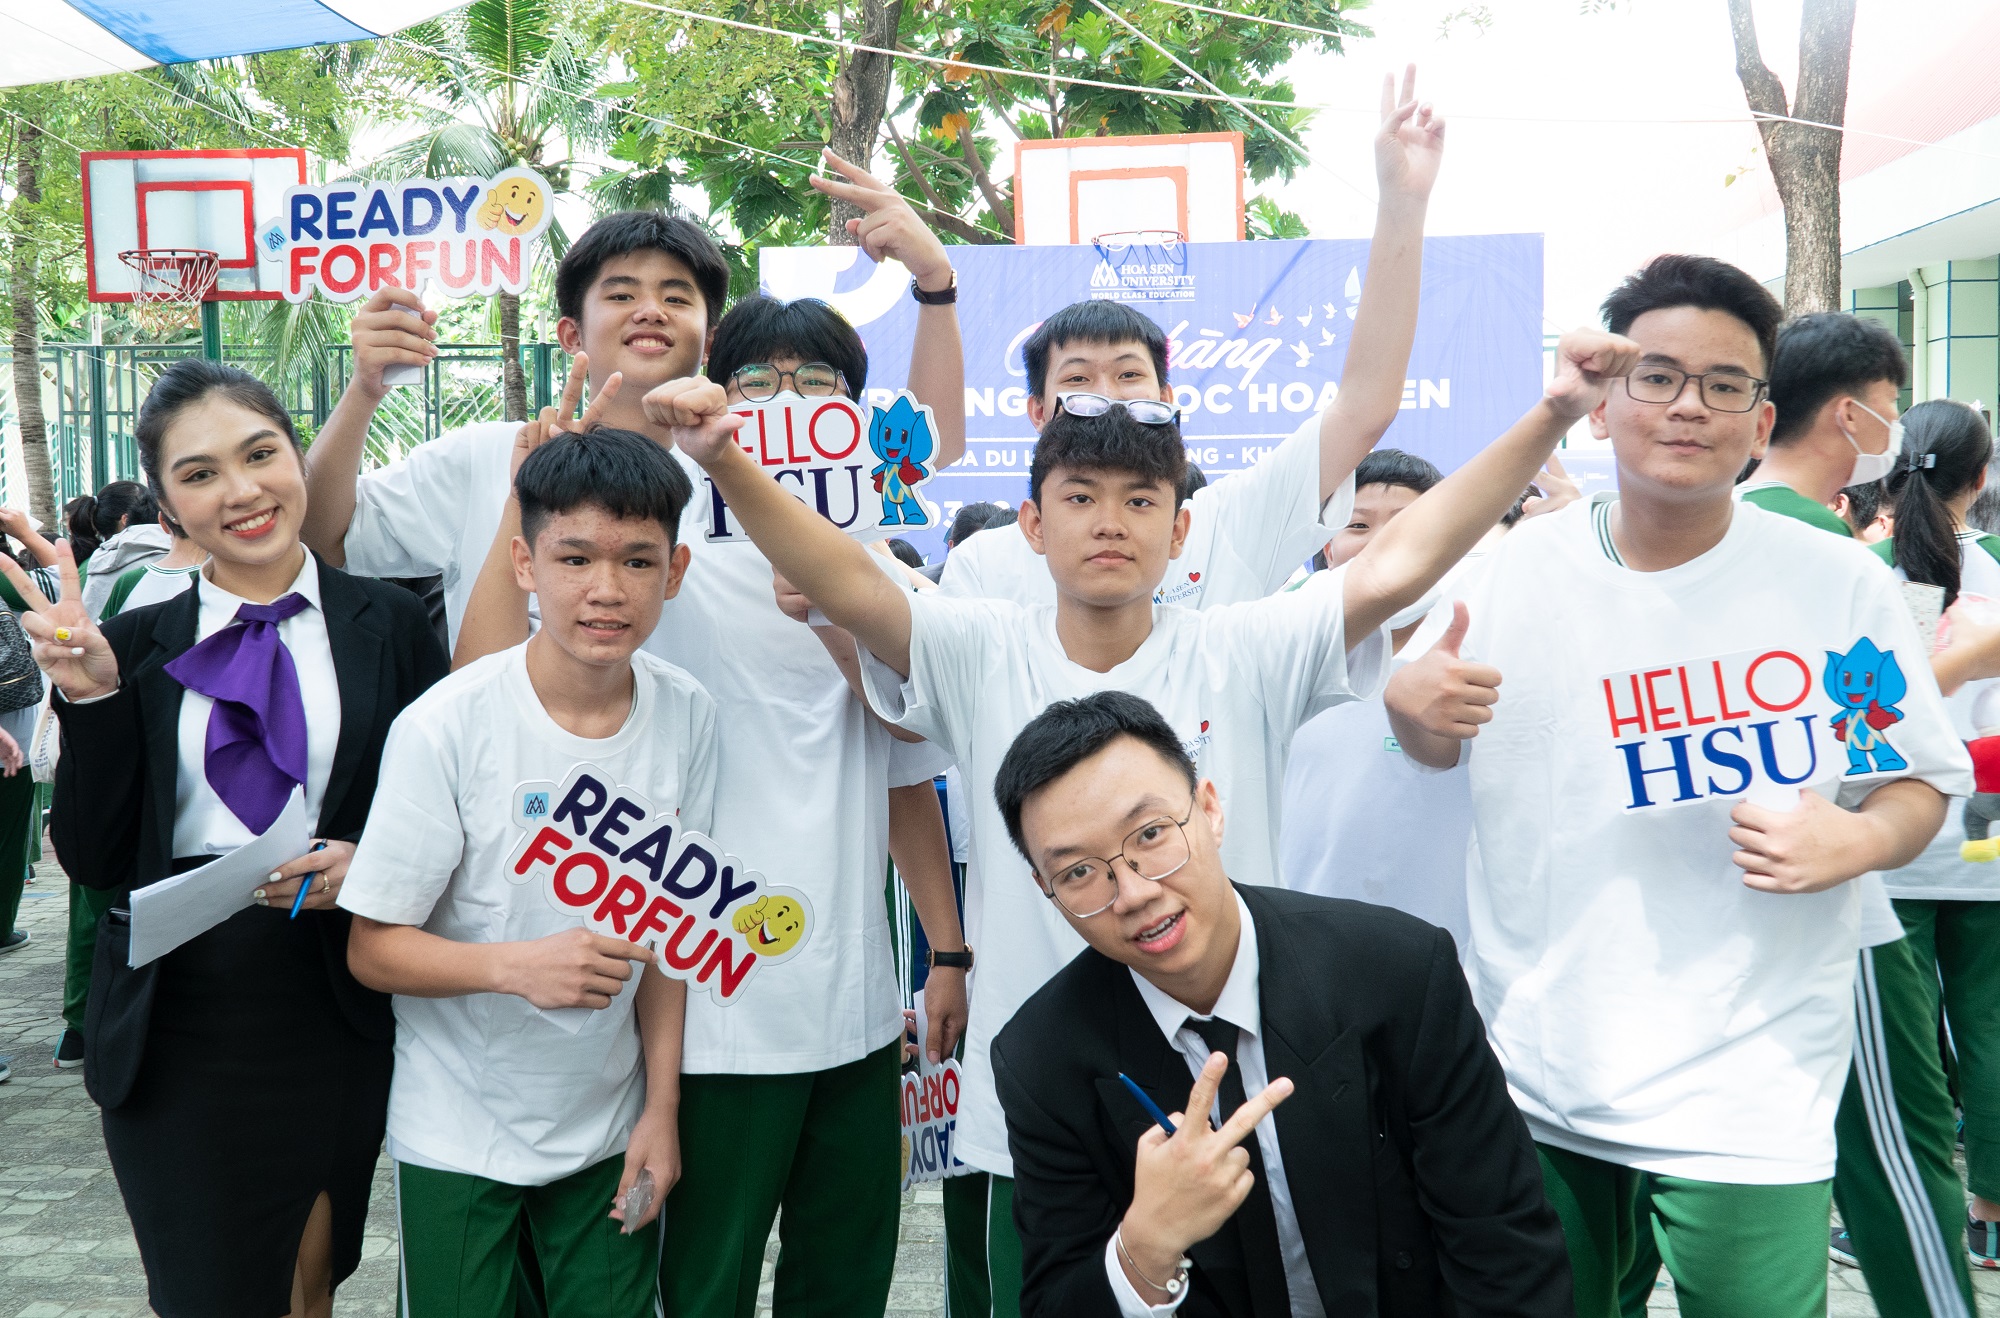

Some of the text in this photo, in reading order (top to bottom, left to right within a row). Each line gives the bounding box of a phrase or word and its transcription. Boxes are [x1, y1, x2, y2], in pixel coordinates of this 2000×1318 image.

[290, 184, 480, 242] READY
[290, 236, 521, 295] FORFUN
[1120, 263, 1175, 275] HOA SEN
[1121, 275, 1196, 287] UNIVERSITY
[1091, 290, 1195, 300] WORLD CLASS EDUCATION
[1173, 383, 1234, 423] ỌC
[1248, 381, 1339, 413] HOA
[1398, 378, 1450, 410] EN
[985, 449, 1018, 467] DU
[1602, 650, 1812, 738] HELLO
[1615, 714, 1818, 809] HSU
[552, 773, 757, 920] READY
[514, 826, 757, 998] FORFUN
[901, 1067, 960, 1128] ORFU
[911, 1120, 964, 1176] ADY
